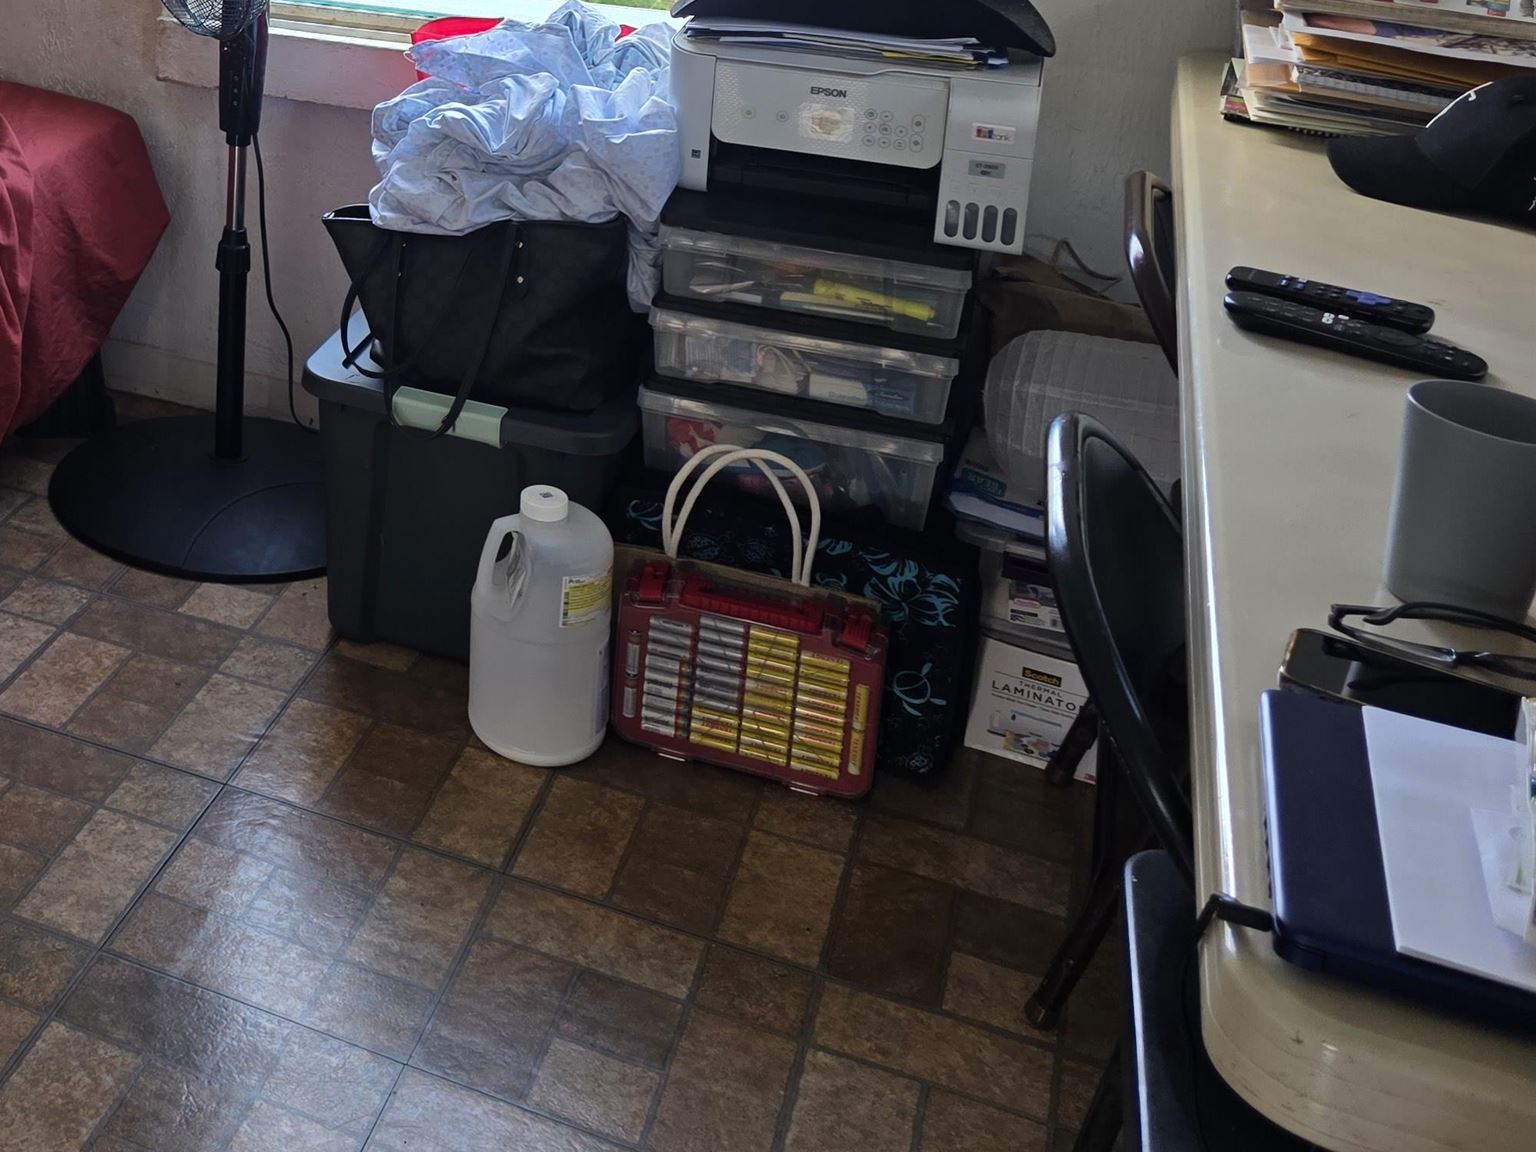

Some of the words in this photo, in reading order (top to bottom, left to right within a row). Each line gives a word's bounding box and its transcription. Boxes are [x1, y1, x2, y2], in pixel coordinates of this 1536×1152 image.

[810, 86, 847, 98] EPSON
[1023, 669, 1061, 686] Scotch
[991, 680, 1076, 711] LAMINATO
[1019, 681, 1062, 698] THERMAL
